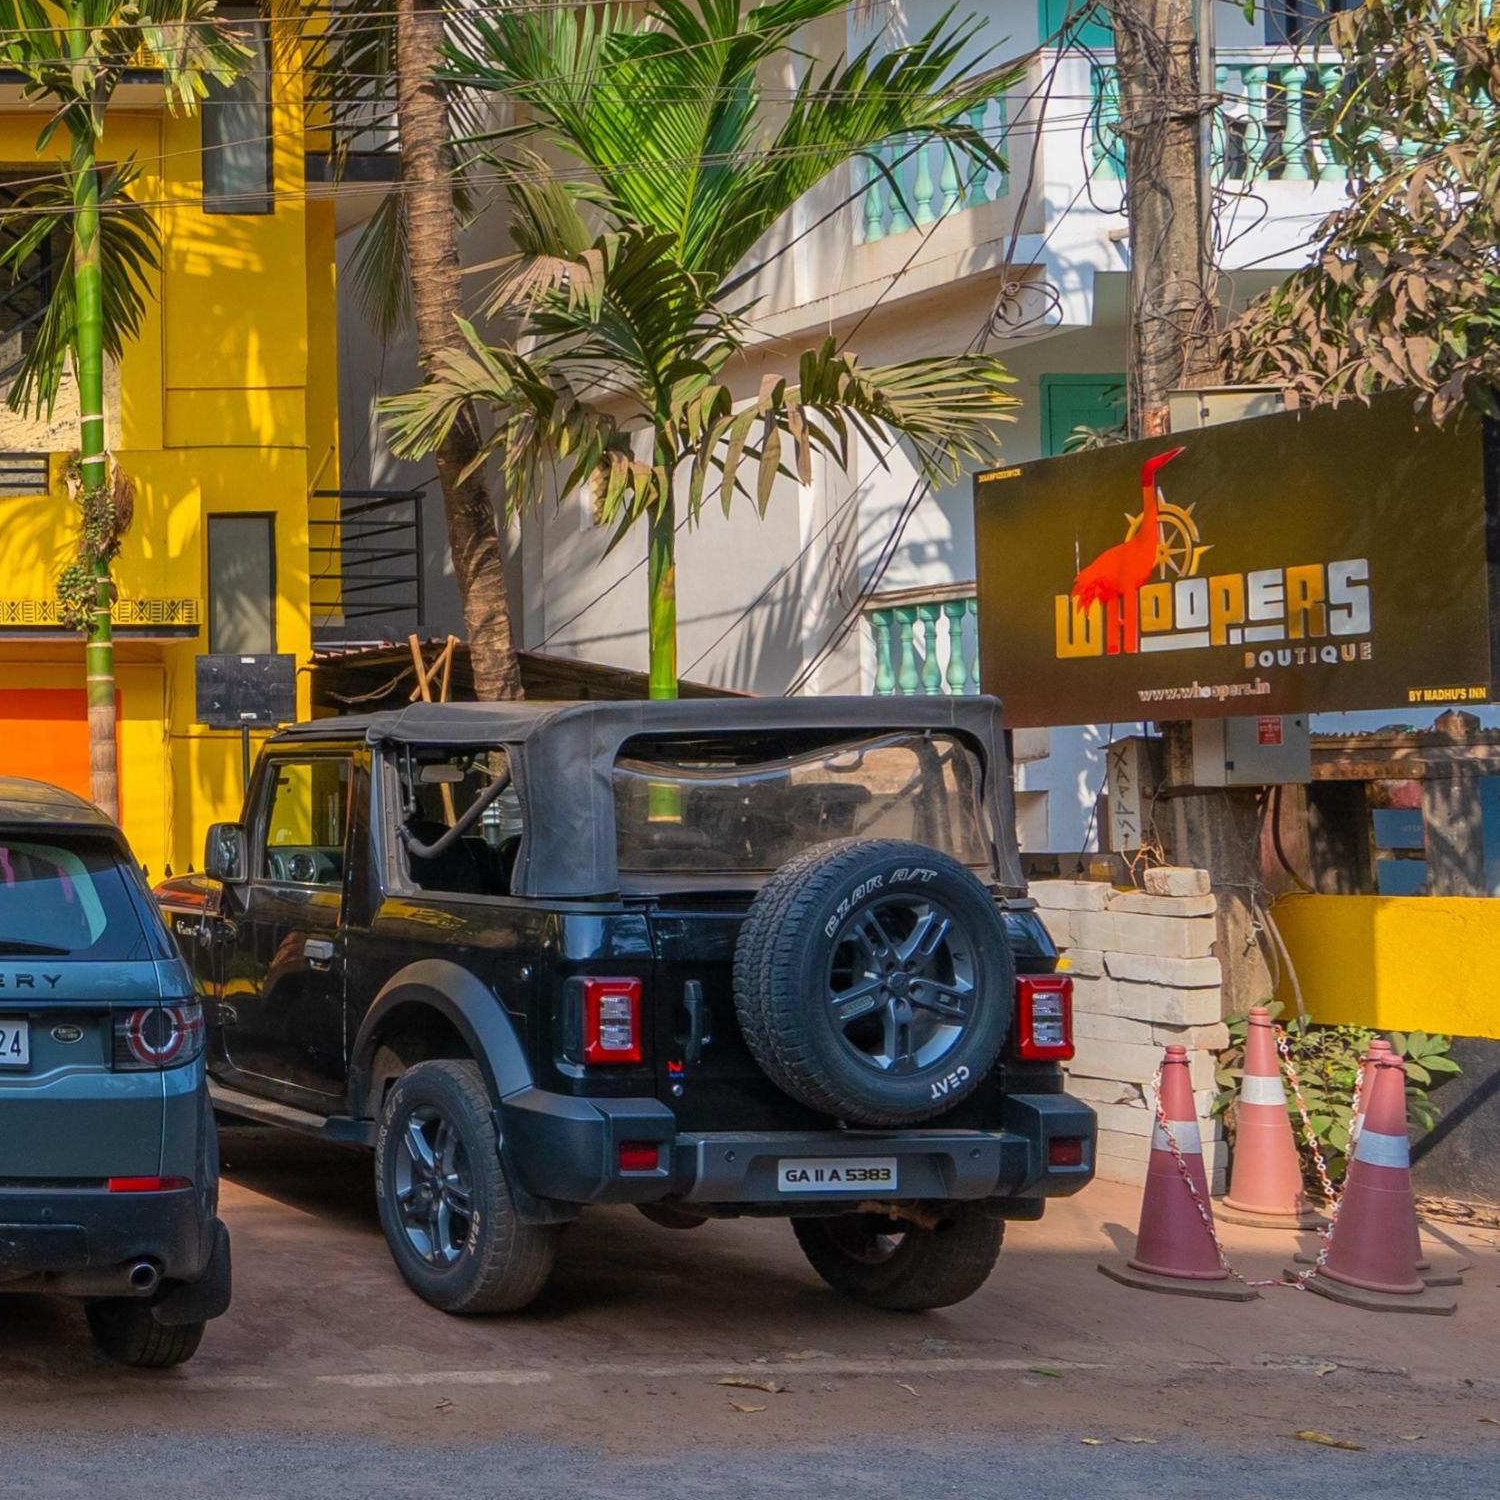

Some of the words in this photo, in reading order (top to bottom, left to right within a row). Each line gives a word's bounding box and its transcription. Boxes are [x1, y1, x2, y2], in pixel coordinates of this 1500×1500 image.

[1055, 558, 1372, 659] WHOOPERS
[1244, 642, 1373, 669] BOUTIQUE
[1137, 677, 1271, 701] www.whoopers.in
[1408, 690, 1422, 702] BY
[1424, 688, 1467, 701] MADHU'S
[1468, 687, 1487, 699] INN
[930, 1065, 970, 1100] CEAT
[785, 1169, 811, 1182] GA
[828, 1169, 842, 1182] A
[845, 1168, 892, 1182] 5383
